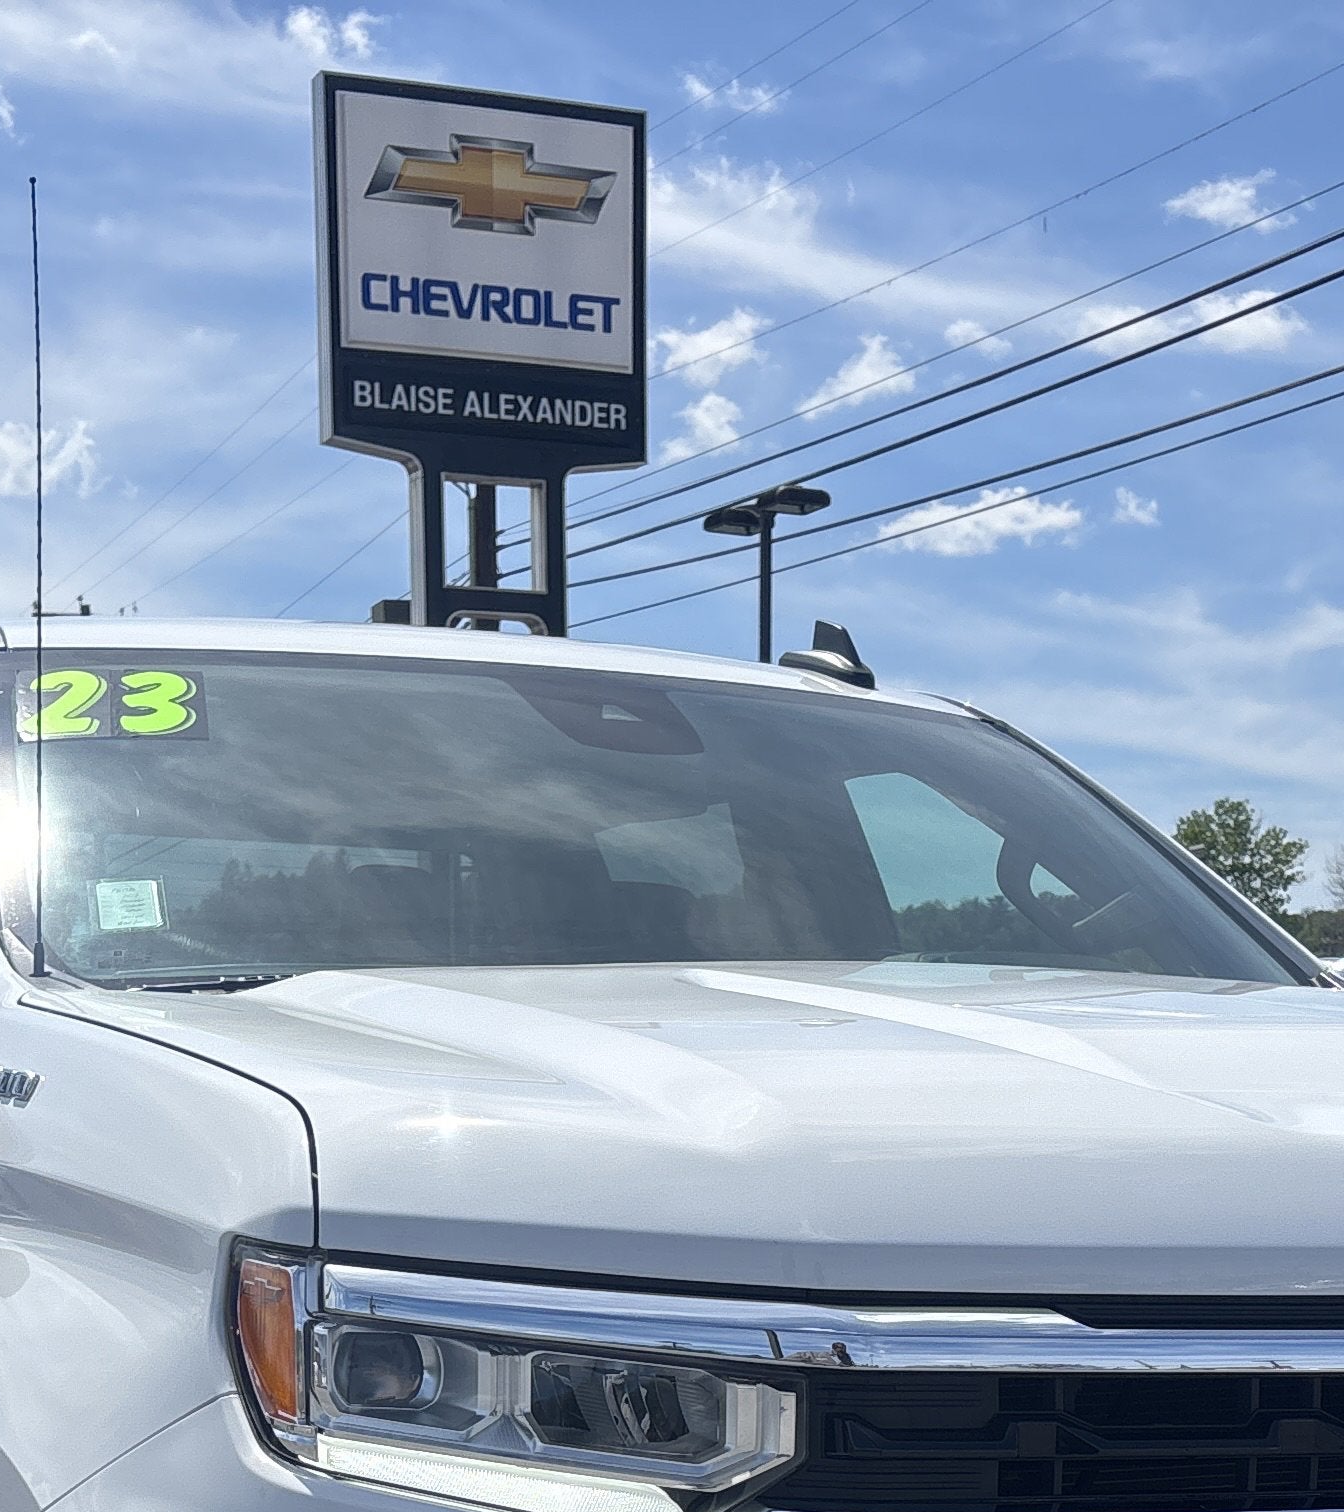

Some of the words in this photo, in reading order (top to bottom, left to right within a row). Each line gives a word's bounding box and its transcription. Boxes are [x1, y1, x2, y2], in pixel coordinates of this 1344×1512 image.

[362, 272, 620, 333] CHEVROLET
[353, 379, 455, 416] BLAISE
[462, 390, 627, 430] ALEXANDER
[20, 670, 197, 735] 23
